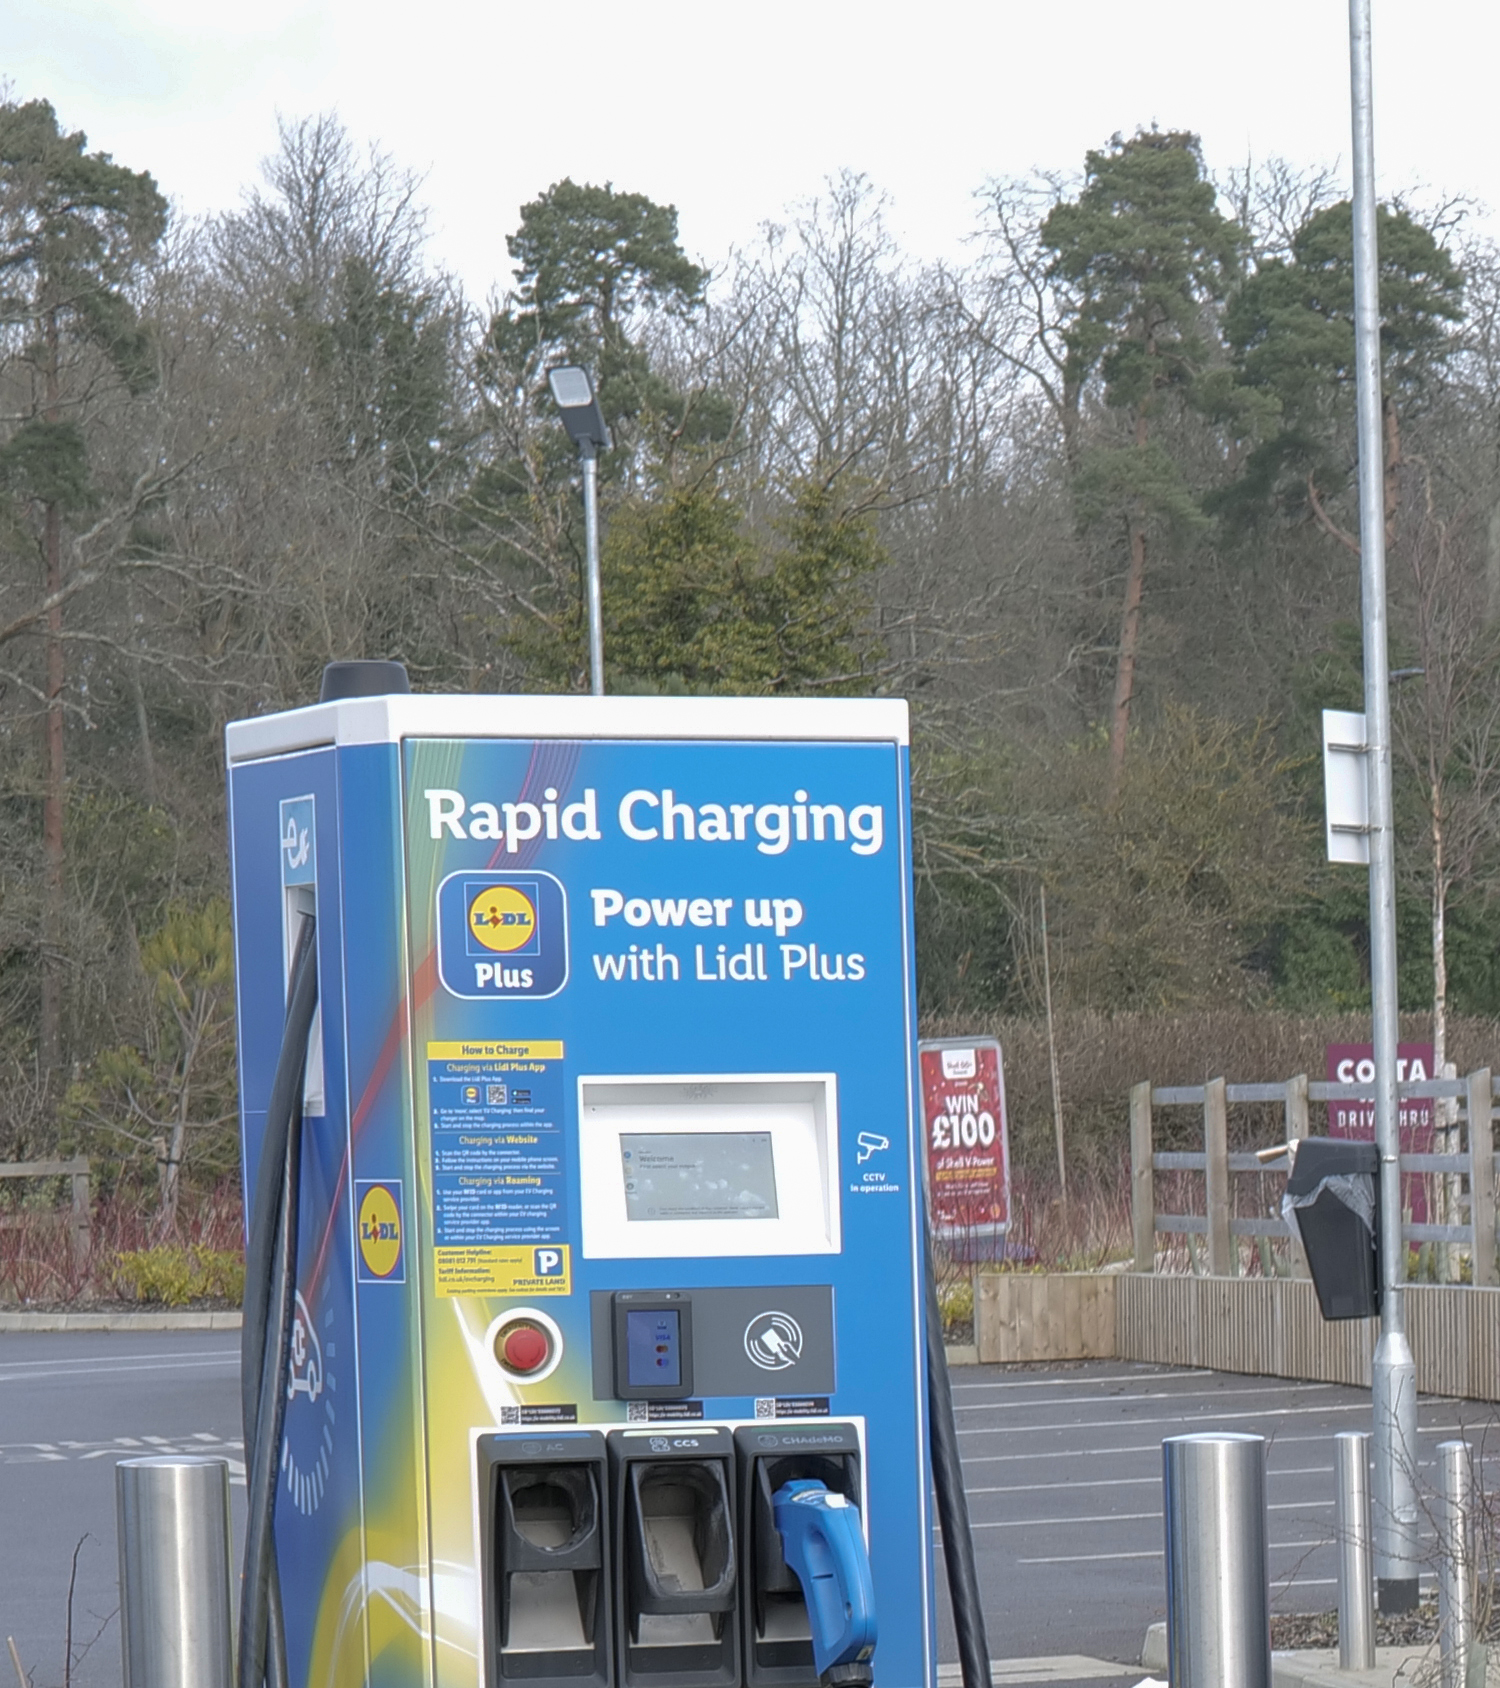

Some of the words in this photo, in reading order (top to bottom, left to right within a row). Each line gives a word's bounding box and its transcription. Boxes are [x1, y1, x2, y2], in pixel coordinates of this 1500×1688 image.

[424, 787, 601, 853] Rapid
[618, 789, 884, 855] Charging
[473, 906, 531, 928] LIDL
[590, 888, 732, 927] Power
[745, 899, 802, 936] up
[593, 944, 679, 981] with
[695, 944, 767, 981] Lidl
[780, 944, 865, 981] Plus
[475, 963, 533, 988] Plus
[462, 1045, 482, 1055] How
[485, 1044, 494, 1055] to
[497, 1044, 529, 1057] Charge
[446, 1063, 480, 1074] Charging
[483, 1063, 492, 1072] via
[495, 1063, 509, 1071] Lidl
[511, 1062, 527, 1071] Plus
[529, 1062, 545, 1073] App
[1336, 1058, 1427, 1084] COTA
[945, 1094, 979, 1114] WIN
[1337, 1110, 1376, 1128] DRIV
[1399, 1109, 1429, 1127] HRU
[459, 1135, 492, 1146] Charging
[495, 1135, 504, 1143] via
[507, 1134, 538, 1143] Website
[932, 1111, 995, 1150] £100
[946, 1157, 965, 1169] Shell
[459, 1176, 492, 1187] Charging
[494, 1176, 504, 1184] via
[506, 1176, 541, 1186] Roaming
[863, 1172, 885, 1181] CCTV
[850, 1183, 858, 1192] in
[860, 1183, 899, 1194] operation
[362, 1213, 399, 1245] LIDL
[538, 1250, 559, 1274] P
[546, 1443, 564, 1451] AC
[673, 1439, 699, 1447] CCS
[782, 1435, 843, 1445] CHAdeMO
